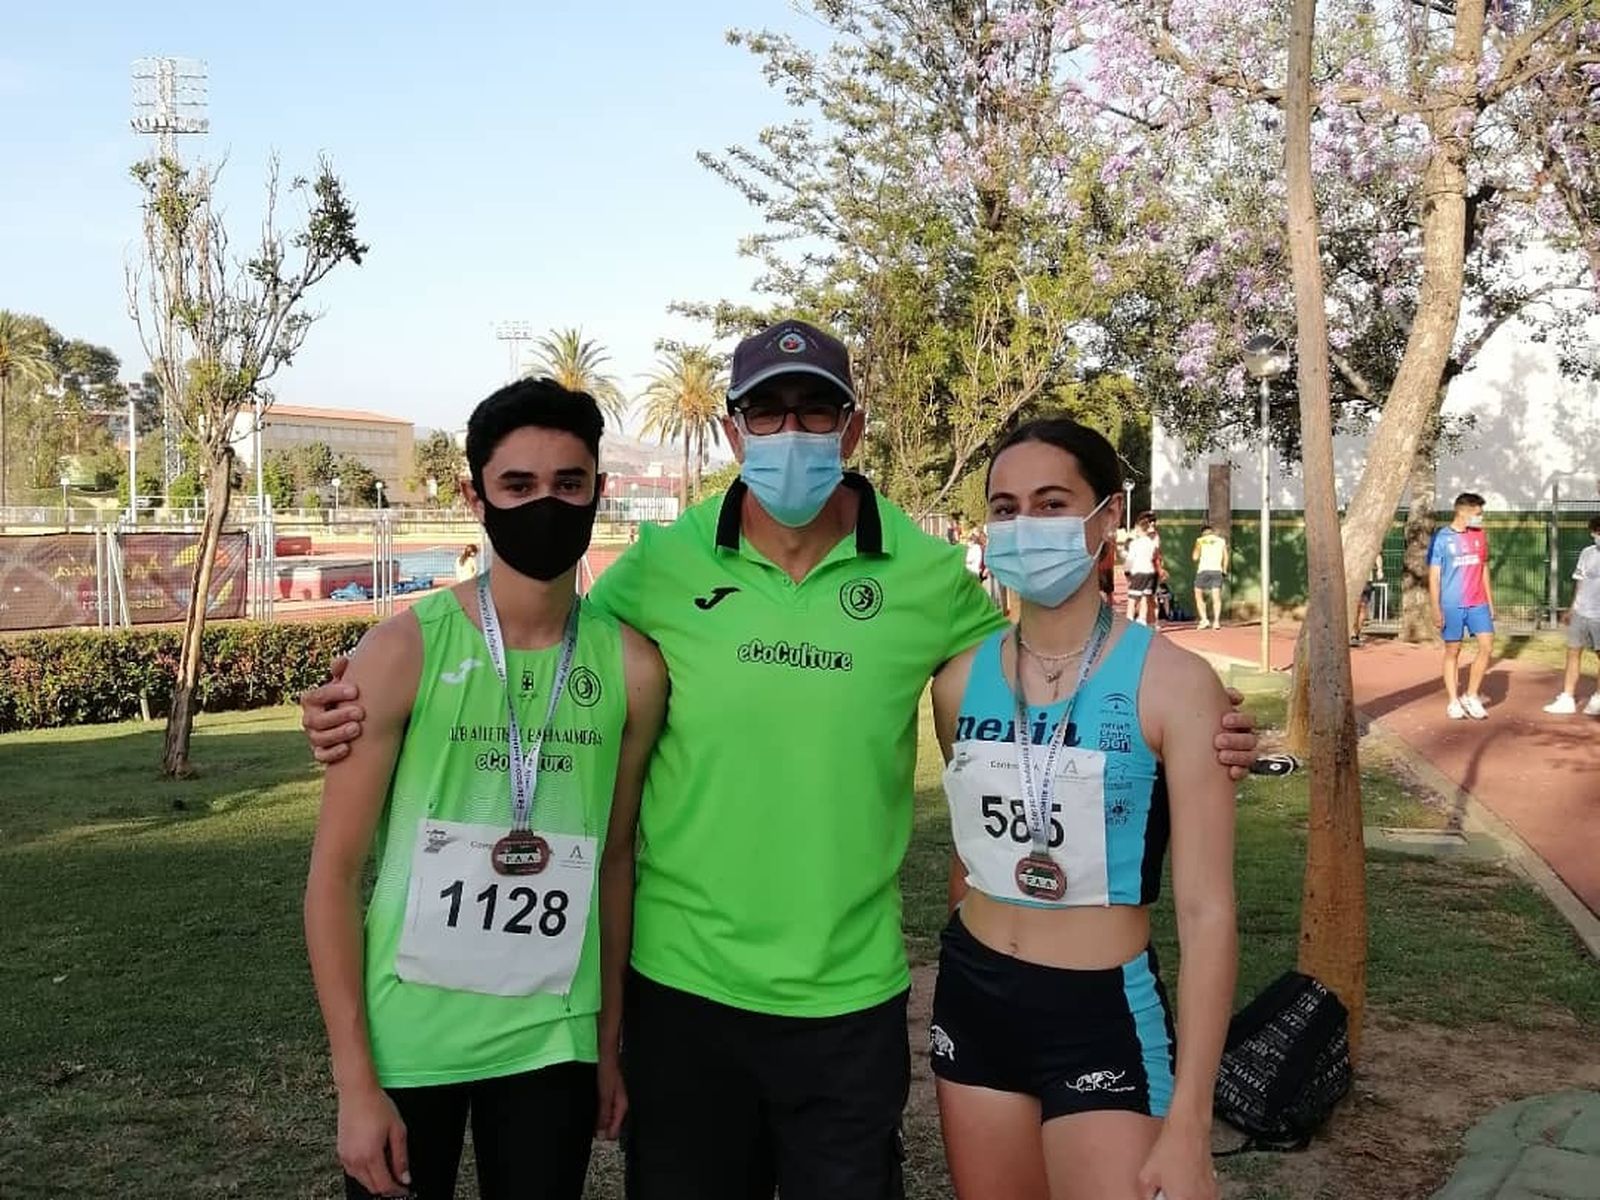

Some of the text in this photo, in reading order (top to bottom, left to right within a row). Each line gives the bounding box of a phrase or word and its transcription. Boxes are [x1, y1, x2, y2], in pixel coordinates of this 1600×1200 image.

[737, 638, 853, 672] eCoCulture
[475, 748, 573, 773] eCoture
[981, 795, 1064, 848] 585
[440, 880, 569, 937] 1128
